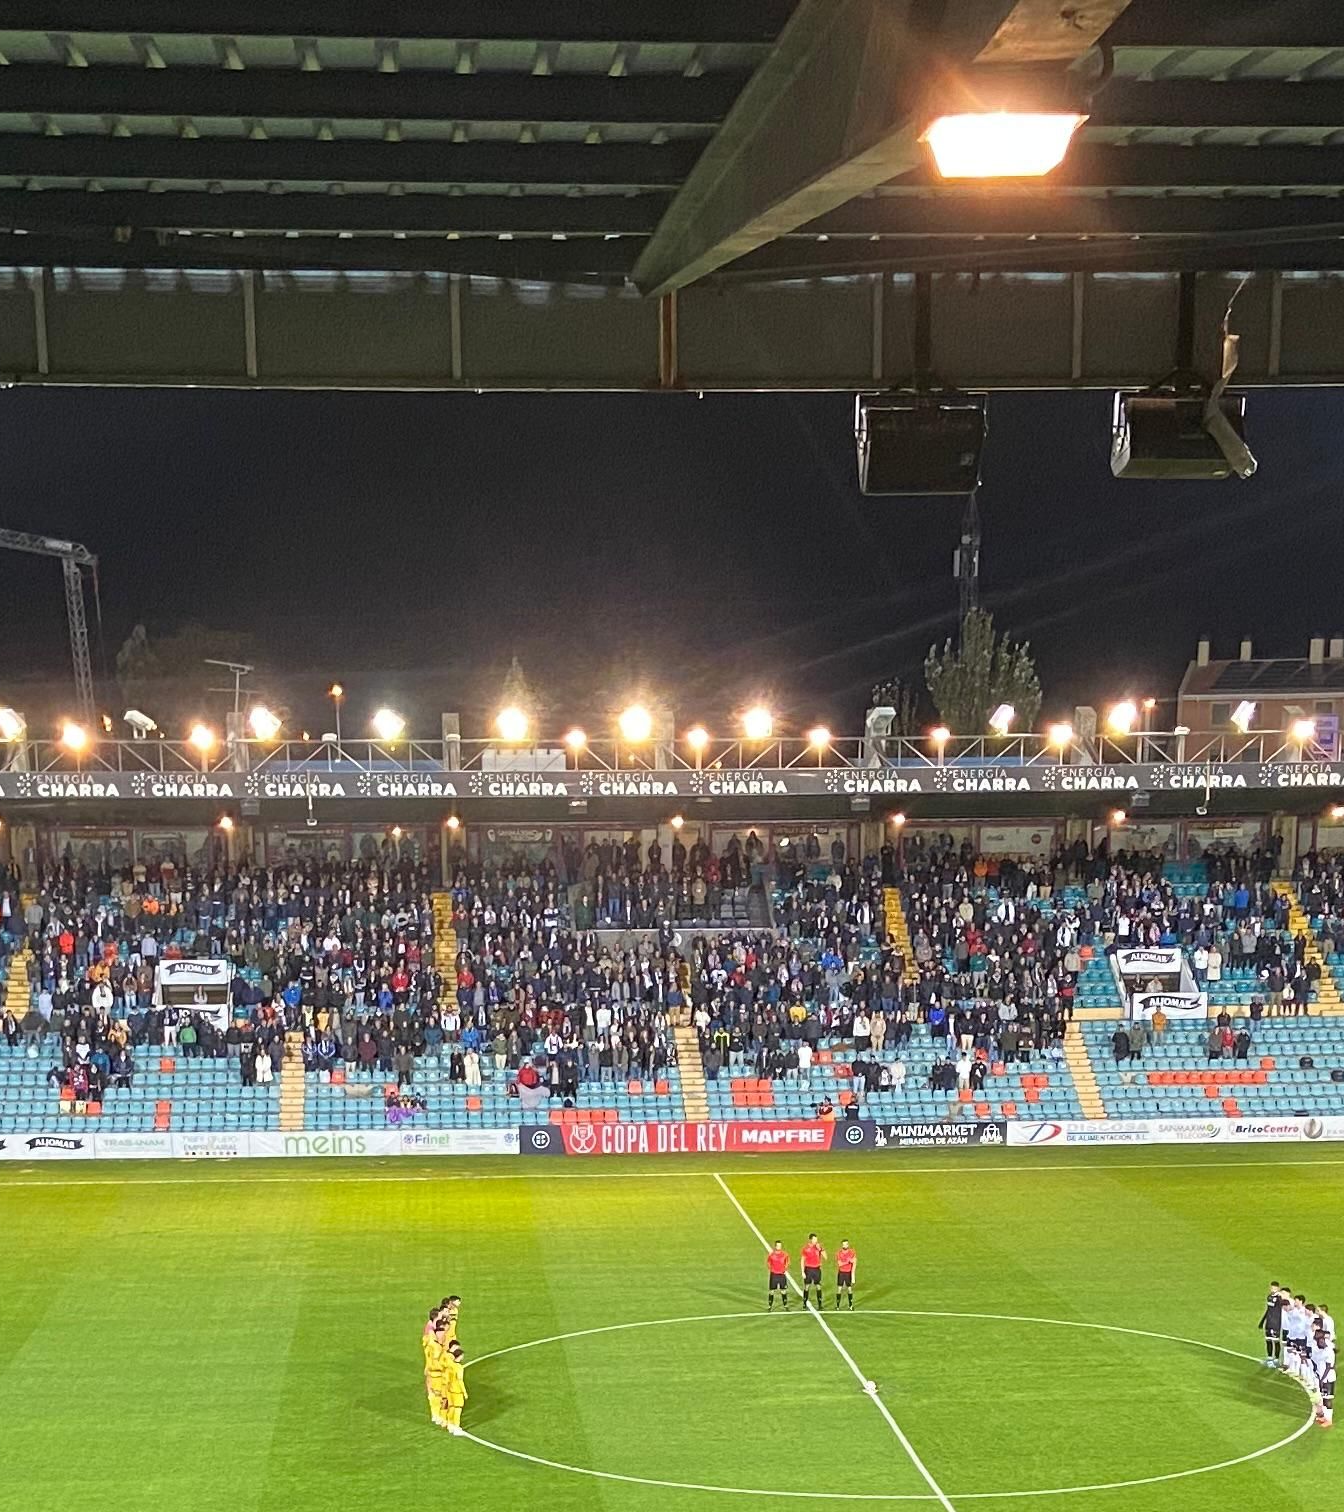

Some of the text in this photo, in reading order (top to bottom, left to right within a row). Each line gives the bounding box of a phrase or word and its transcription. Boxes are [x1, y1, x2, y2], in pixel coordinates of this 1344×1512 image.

[264, 773, 321, 784] ENERGA
[952, 778, 1031, 791] CHARRA
[1061, 777, 1139, 790] CHARRA
[1169, 774, 1247, 788] CHARRA
[37, 784, 120, 796] CHARRA
[151, 784, 233, 796] CHARRA
[265, 783, 346, 796] CHARRA
[377, 783, 458, 796] CHARRA
[489, 783, 568, 796] CHARRA
[599, 782, 678, 795] CHARRA
[709, 781, 788, 794] CHARRA
[843, 779, 922, 792] CHARRA
[890, 1124, 978, 1137] MINIMARKET
[1067, 1123, 1149, 1132] DISCOSA
[1236, 1124, 1299, 1134] BricoCentro
[35, 1138, 76, 1149] ALJOMAR
[285, 1134, 367, 1155] meins
[602, 1124, 825, 1153] COPA DEL REY MAPFRE
[899, 1137, 934, 1145] MIRANDA
[936, 1137, 946, 1145] DE
